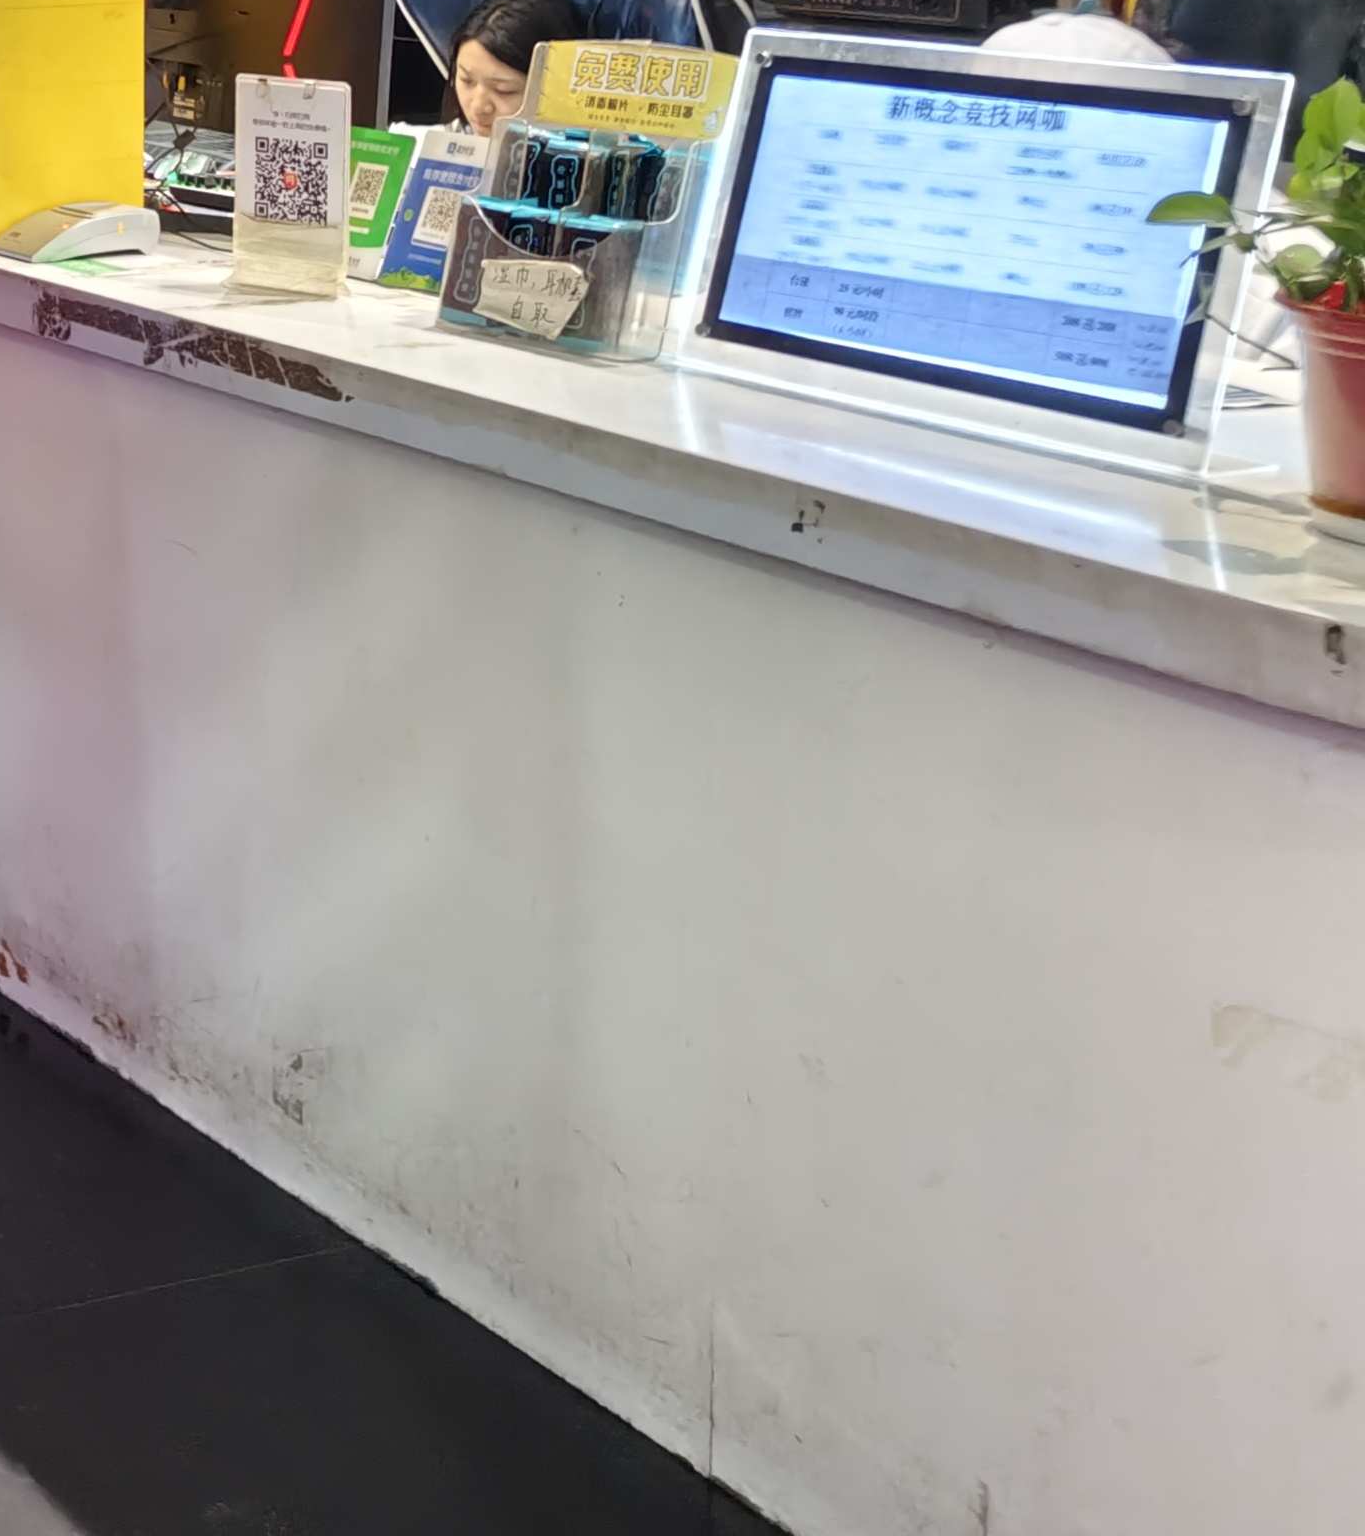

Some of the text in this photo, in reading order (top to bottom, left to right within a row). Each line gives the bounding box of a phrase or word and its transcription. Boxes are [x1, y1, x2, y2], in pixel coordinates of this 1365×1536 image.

[573, 50, 709, 99] 免费使用
[888, 95, 1067, 132] 新概念竞技网咖
[510, 301, 556, 325] 自取
